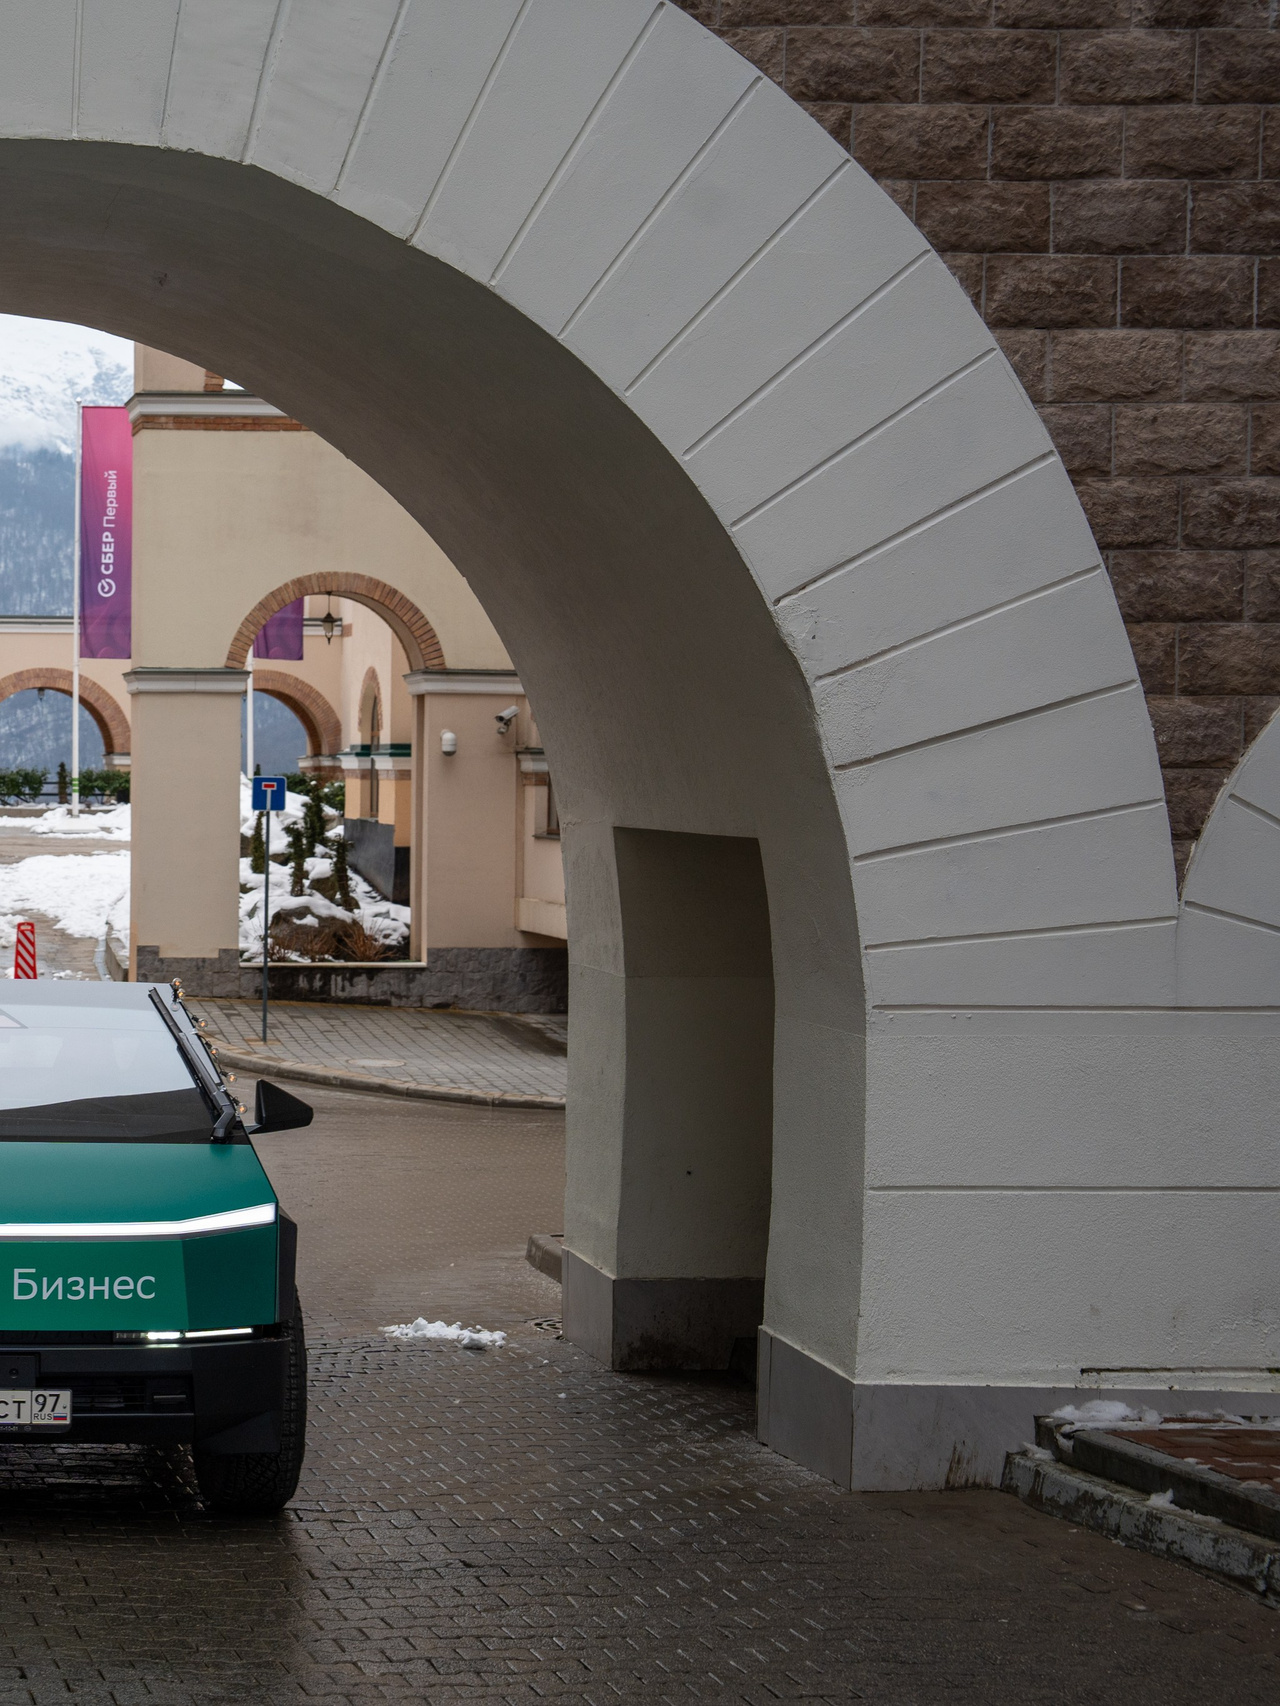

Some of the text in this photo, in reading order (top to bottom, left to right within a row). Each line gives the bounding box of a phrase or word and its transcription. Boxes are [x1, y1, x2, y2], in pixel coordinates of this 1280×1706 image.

[100, 470, 118, 575] СБЕР Первый
[12, 1268, 156, 1301] Бизнес
[34, 1393, 61, 1413] 97
[33, 1413, 52, 1421] RUS
